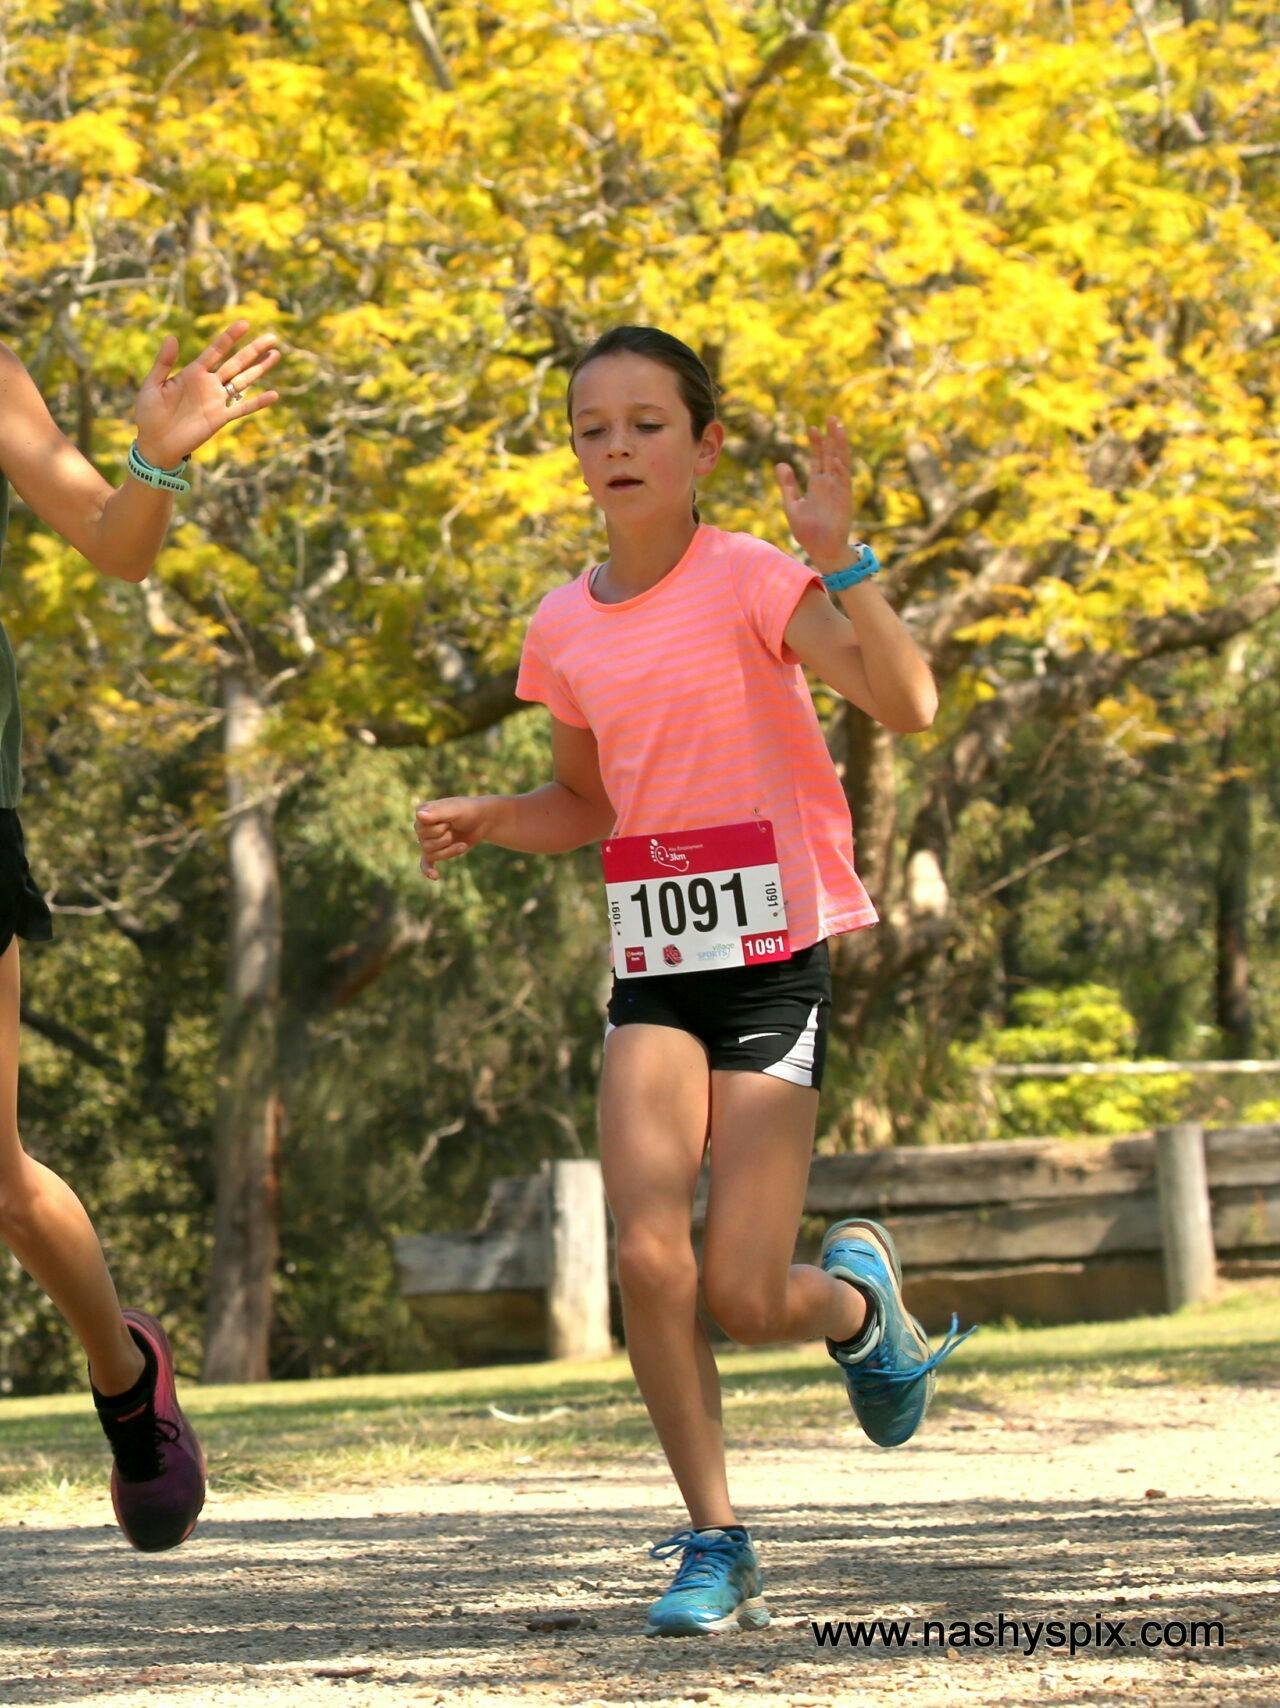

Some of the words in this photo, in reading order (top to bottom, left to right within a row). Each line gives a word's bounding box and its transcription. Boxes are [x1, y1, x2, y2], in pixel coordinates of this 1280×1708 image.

[669, 853, 687, 862] 3km
[630, 872, 748, 938] 1091
[764, 881, 779, 908] 1091
[611, 900, 622, 926] 1091
[744, 936, 785, 957] 1091
